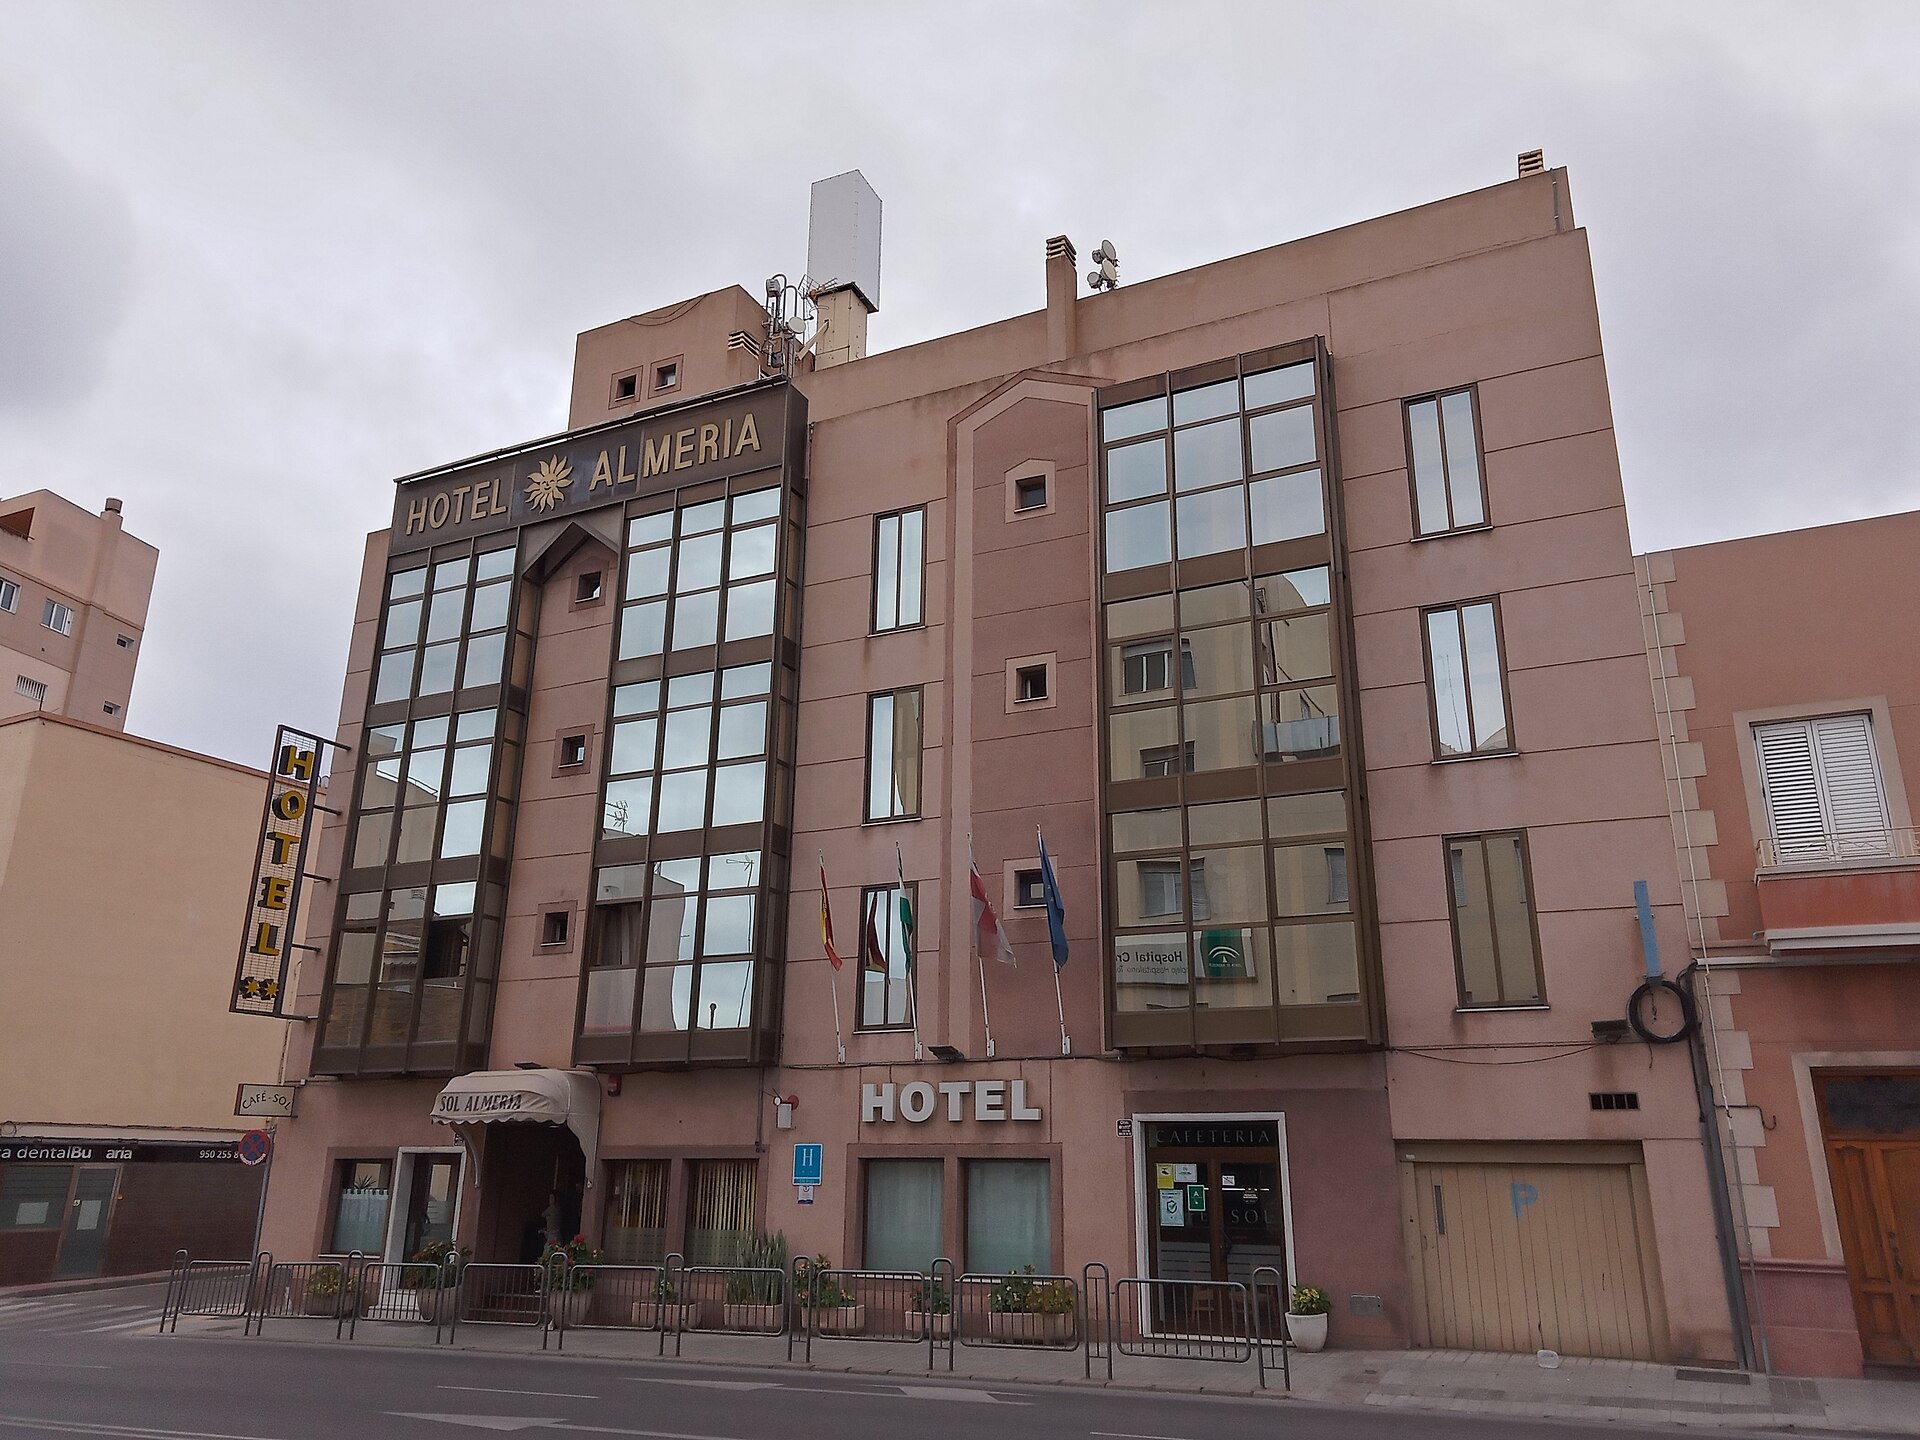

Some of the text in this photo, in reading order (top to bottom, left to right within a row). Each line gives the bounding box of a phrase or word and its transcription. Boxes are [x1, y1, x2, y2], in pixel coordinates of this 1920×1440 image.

[405, 413, 762, 535] HOTEL ALMERIA
[251, 745, 314, 957] HOTEL
[440, 1094, 522, 1112] SOL ALMERIA
[862, 1080, 1042, 1122] HOTEL
[1155, 1130, 1270, 1144] CAFETERIA
[0, 1148, 12, 1160] a
[199, 1150, 216, 1159] 950
[216, 1150, 232, 1159] 255
[802, 1148, 814, 1167] H
[1510, 1183, 1539, 1217] P
[1230, 1209, 1273, 1224] SOL
